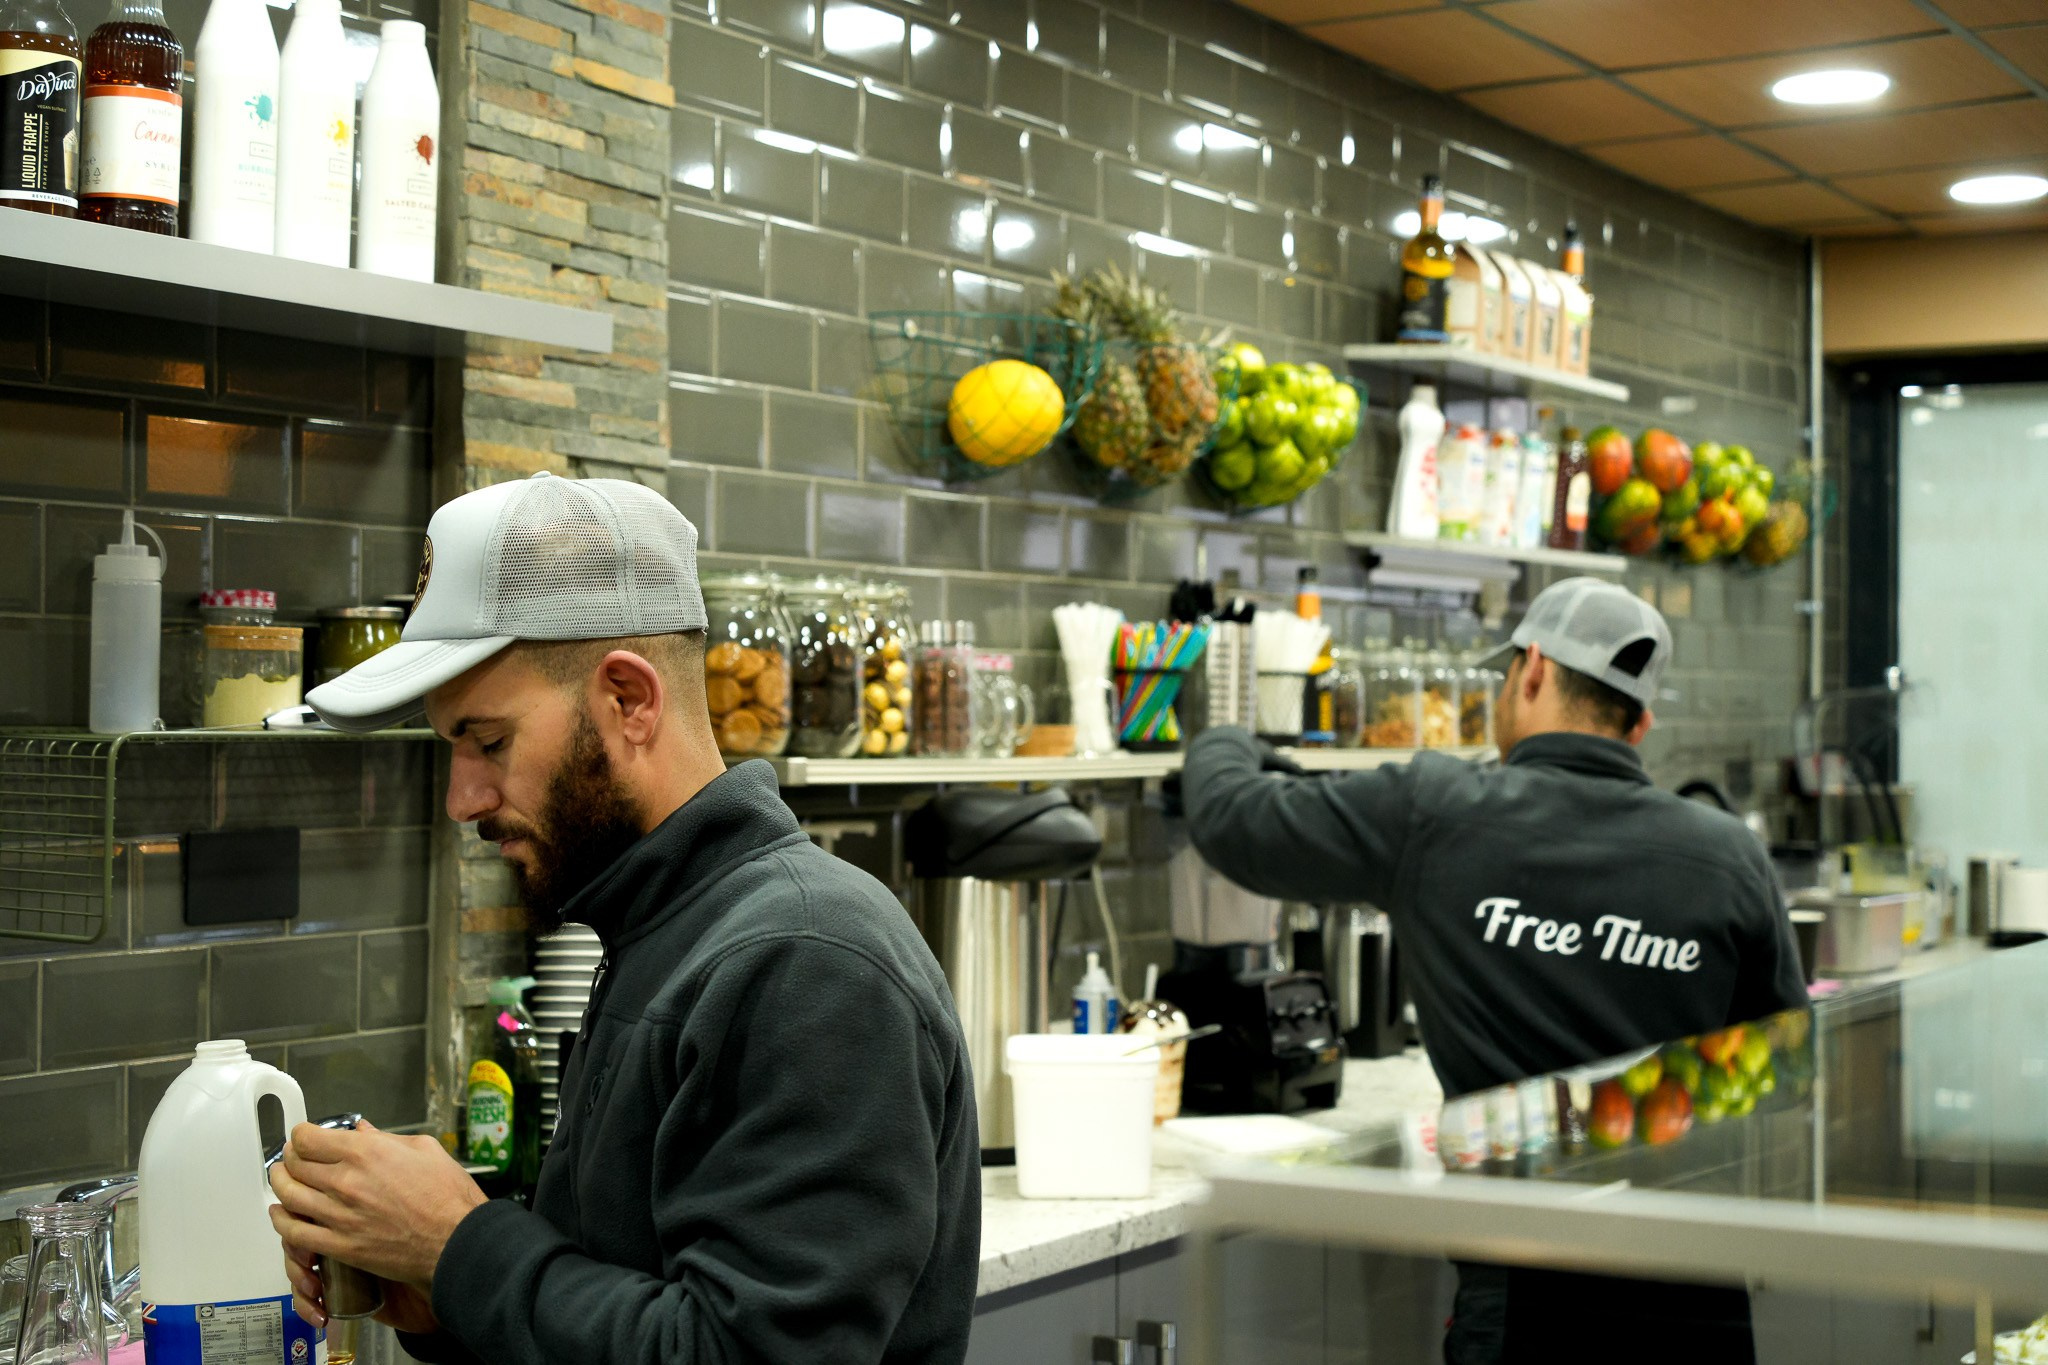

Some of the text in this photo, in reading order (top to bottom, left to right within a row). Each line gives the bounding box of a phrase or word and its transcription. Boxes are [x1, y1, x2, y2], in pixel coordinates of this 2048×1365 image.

[17, 72, 77, 101] DaVinci
[21, 112, 38, 189] LIQUID FRAPPE
[1475, 897, 1701, 972] Free Time
